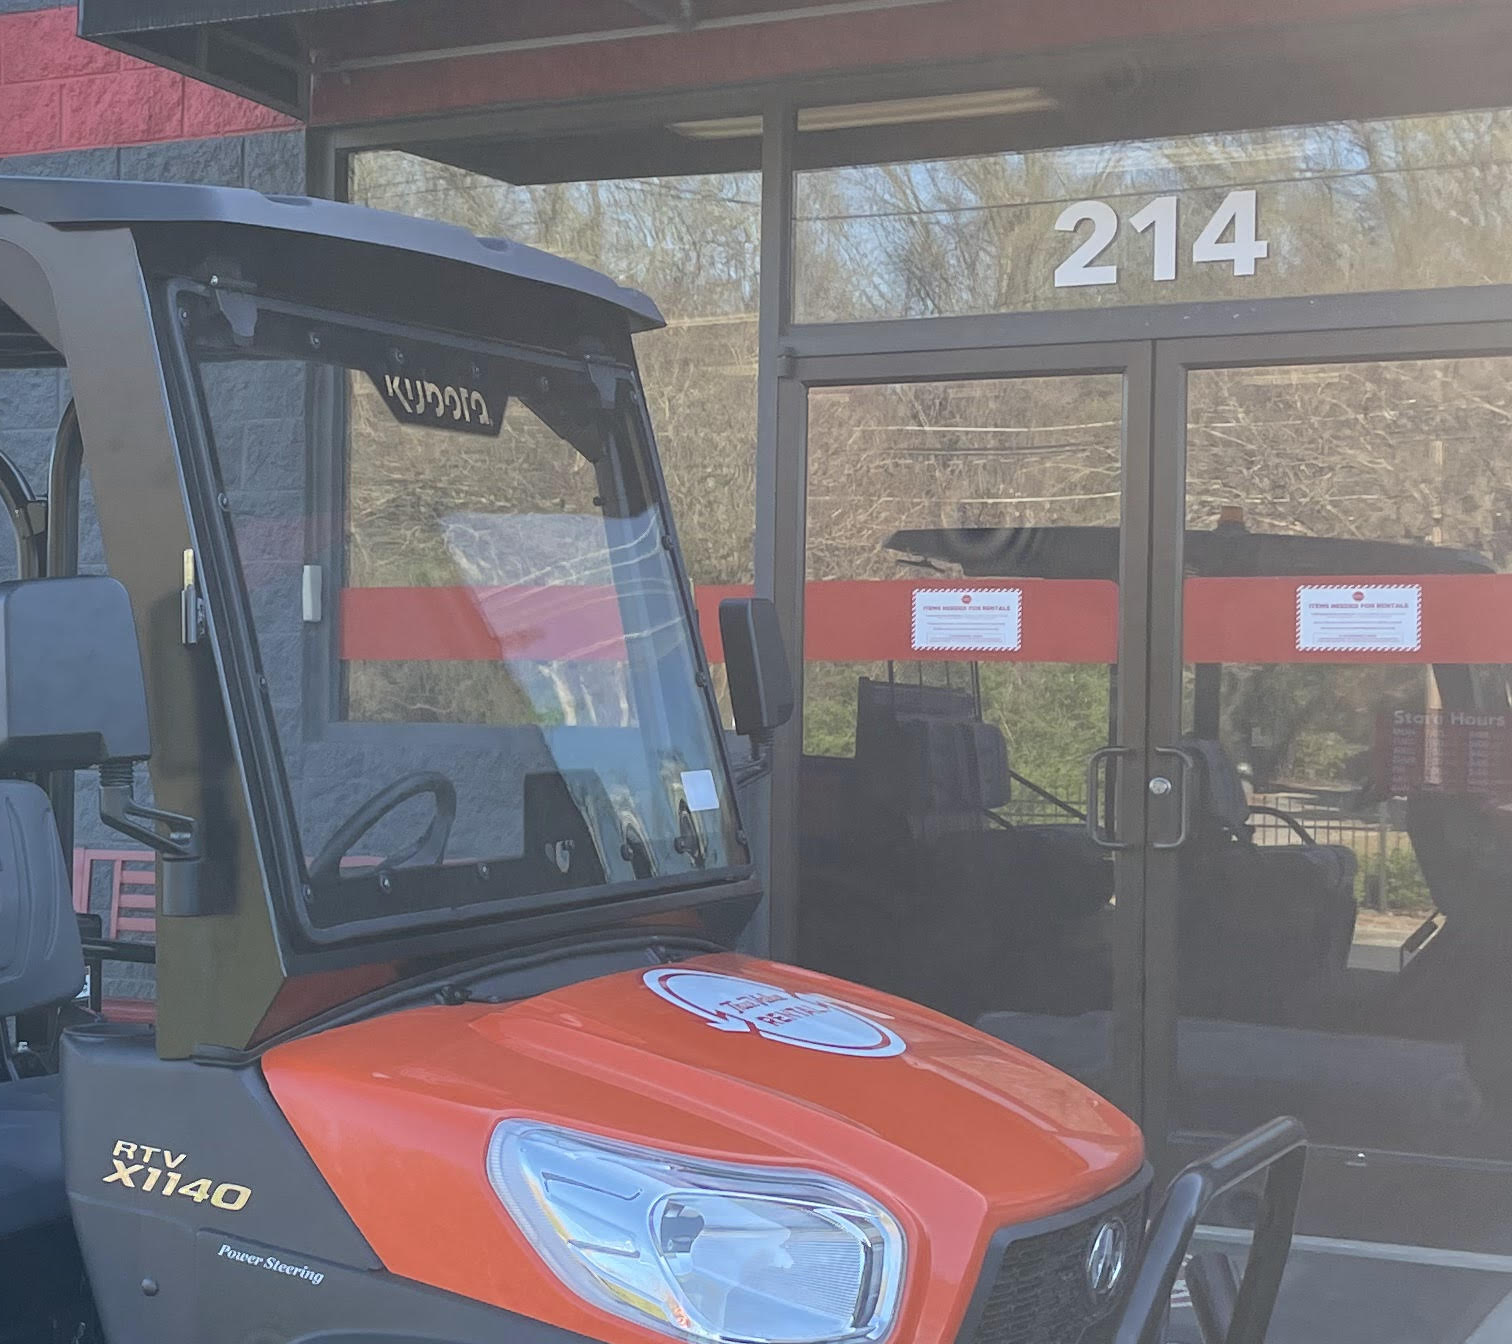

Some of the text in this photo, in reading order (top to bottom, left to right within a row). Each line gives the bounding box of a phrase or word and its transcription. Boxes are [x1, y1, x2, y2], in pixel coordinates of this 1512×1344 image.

[1054, 189, 1268, 287] 214
[1451, 712, 1505, 726] Hours
[113, 1140, 187, 1168] RTV
[102, 1159, 252, 1211] X1140
[218, 1244, 325, 1285] Power Steering
